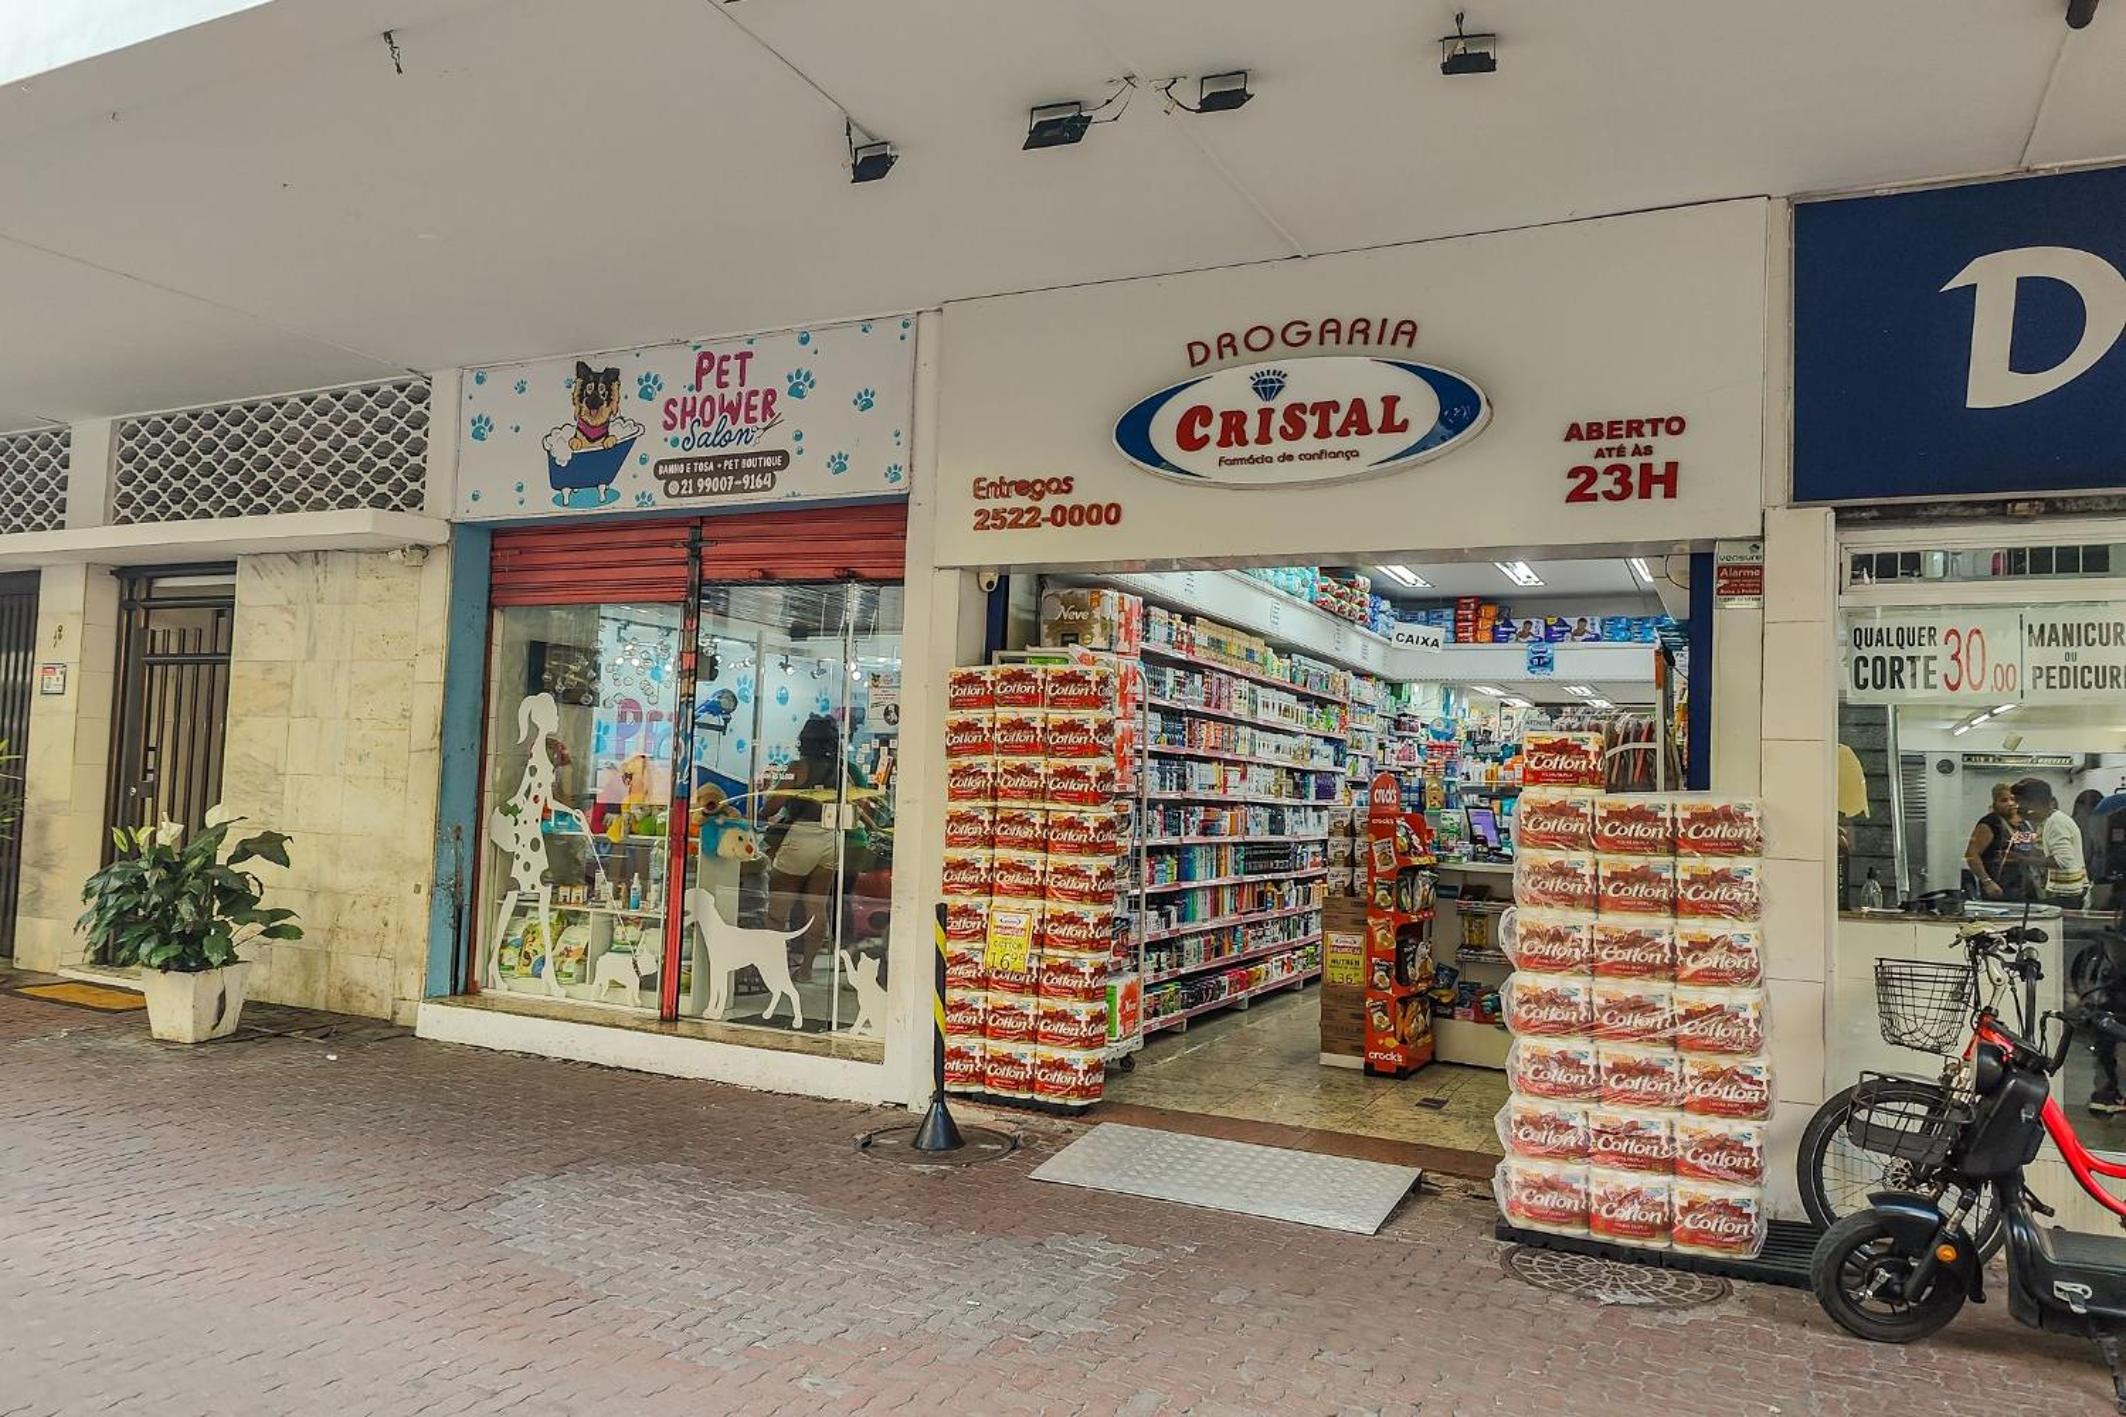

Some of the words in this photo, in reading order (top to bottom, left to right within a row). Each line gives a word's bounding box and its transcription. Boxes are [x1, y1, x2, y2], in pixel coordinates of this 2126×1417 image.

[1187, 317, 1419, 368] DROGARIA
[695, 351, 754, 392] PET
[663, 388, 777, 431] SHOWER
[682, 415, 755, 450] Salon
[1175, 395, 1410, 452] CRISTAL
[1564, 416, 1686, 442] ABERTO
[1277, 452, 1294, 463] de
[1298, 449, 1360, 461] confiança
[1594, 443, 1626, 459] ATÉ
[693, 462, 714, 472] TOSA
[724, 458, 739, 470] PET
[742, 455, 783, 469] BOUTIQUE
[681, 479, 693, 494] 21
[972, 475, 1074, 502] Entregas
[1565, 461, 1679, 503] 23H
[973, 502, 1122, 531] 2522-0000
[1720, 567, 1761, 578] Alarme
[1055, 604, 1089, 620] Neve
[1395, 632, 1440, 648] CAIXA
[1853, 626, 1937, 649] QUALQUER
[2064, 651, 2077, 662] OU
[1853, 655, 1937, 690] CORTE
[2032, 665, 2126, 690] PEDICUR
[950, 683, 985, 698] Cotton
[997, 682, 1035, 695] Cotton
[1050, 683, 1089, 696] Cotton
[946, 732, 983, 746] Cotton
[997, 729, 1035, 743] Cotton
[1050, 732, 1089, 745] Cotton
[1530, 752, 1587, 771] Cotton
[950, 776, 986, 789] Cotton
[1001, 775, 1039, 789] Cotton
[1050, 777, 1089, 792] Cotton
[947, 823, 983, 836] Cotton
[997, 823, 1034, 838] Cotton
[1528, 816, 1585, 834] Cotton
[1604, 820, 1664, 838] Cotton
[1687, 822, 1751, 839] Cotton
[1050, 828, 1088, 843] Cotton
[943, 869, 979, 883] Cotton
[996, 870, 1034, 885] Cotton
[1050, 875, 1090, 892] Cotton
[1528, 877, 1585, 895] Cotton
[1608, 881, 1668, 900] Cotton
[1686, 883, 1750, 902] Cotton
[1047, 921, 1088, 939] Cotton
[1522, 940, 1581, 959] Cotton
[1601, 946, 1662, 963] Cotton
[1687, 951, 1749, 969] Cotton
[1043, 971, 1083, 988] Cotton
[988, 1013, 1027, 1029] Cotton
[1521, 1004, 1577, 1023] Cotton
[1602, 1010, 1666, 1029] Cotton
[1040, 1019, 1080, 1036] Cotton
[1684, 1020, 1746, 1038] Cotton
[987, 1062, 1024, 1079] Cotton
[1037, 1068, 1076, 1085] Cotton
[1528, 1066, 1586, 1085] Cotton
[1610, 1073, 1671, 1094] Cotton
[1695, 1081, 1760, 1102] Cotton
[1519, 1127, 1580, 1147] Cotton
[1598, 1135, 1660, 1157] Cotton
[1686, 1146, 1750, 1169] Cotton
[1521, 1188, 1578, 1212] Cotton
[1601, 1202, 1662, 1224] Cotton
[1684, 1211, 1749, 1237] Cotton
